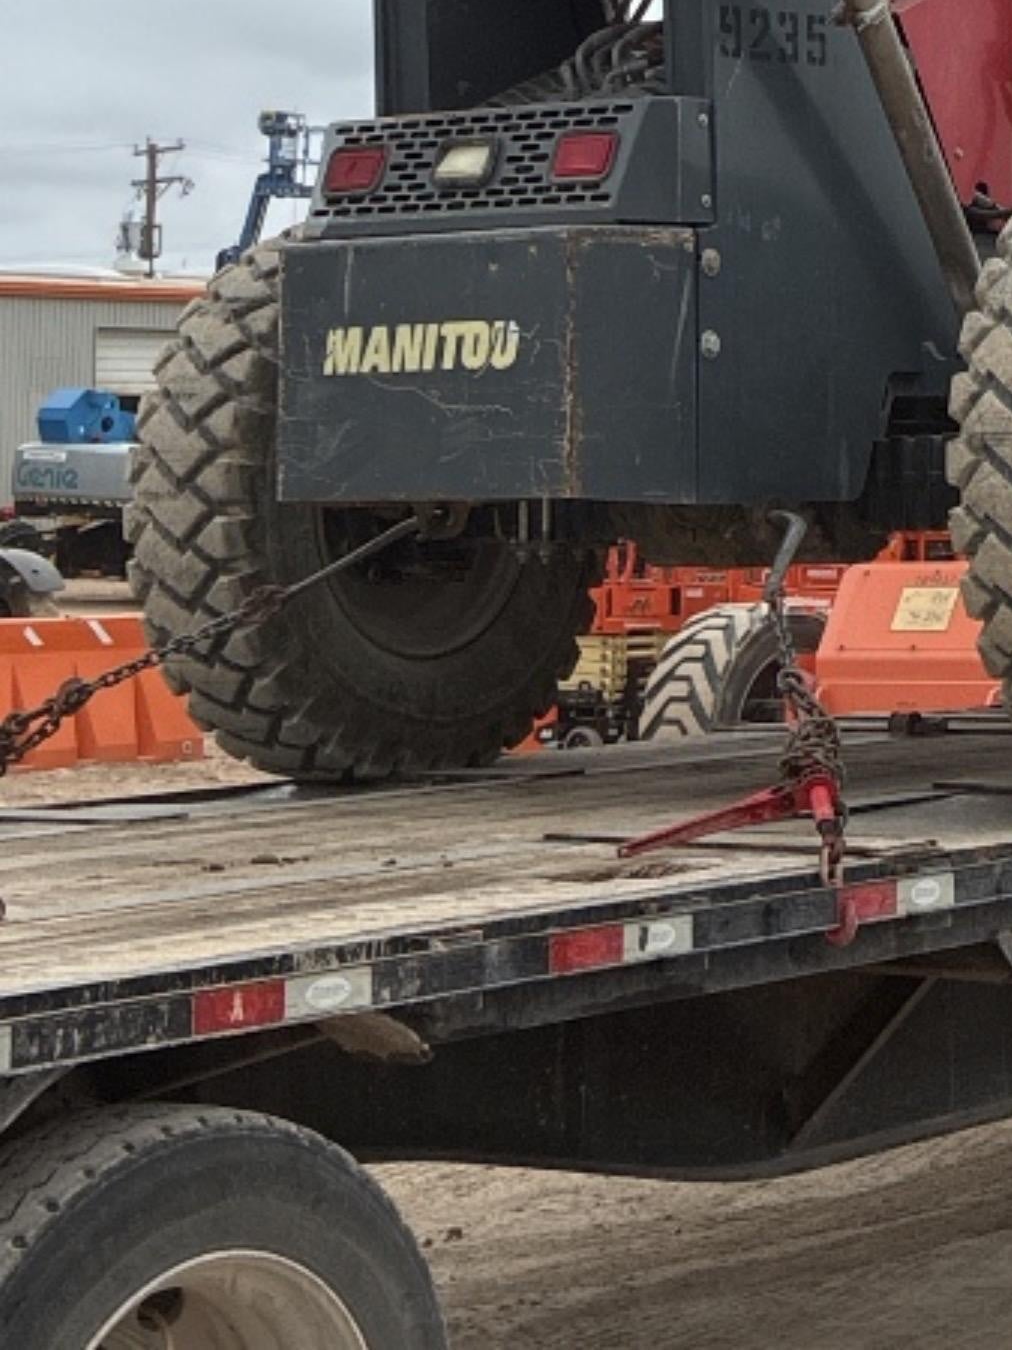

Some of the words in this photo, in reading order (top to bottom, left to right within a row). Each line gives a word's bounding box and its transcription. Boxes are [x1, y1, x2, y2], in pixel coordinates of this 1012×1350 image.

[719, 4, 826, 67] 9235
[322, 319, 521, 376] MANITOU
[17, 459, 79, 490] Genie
